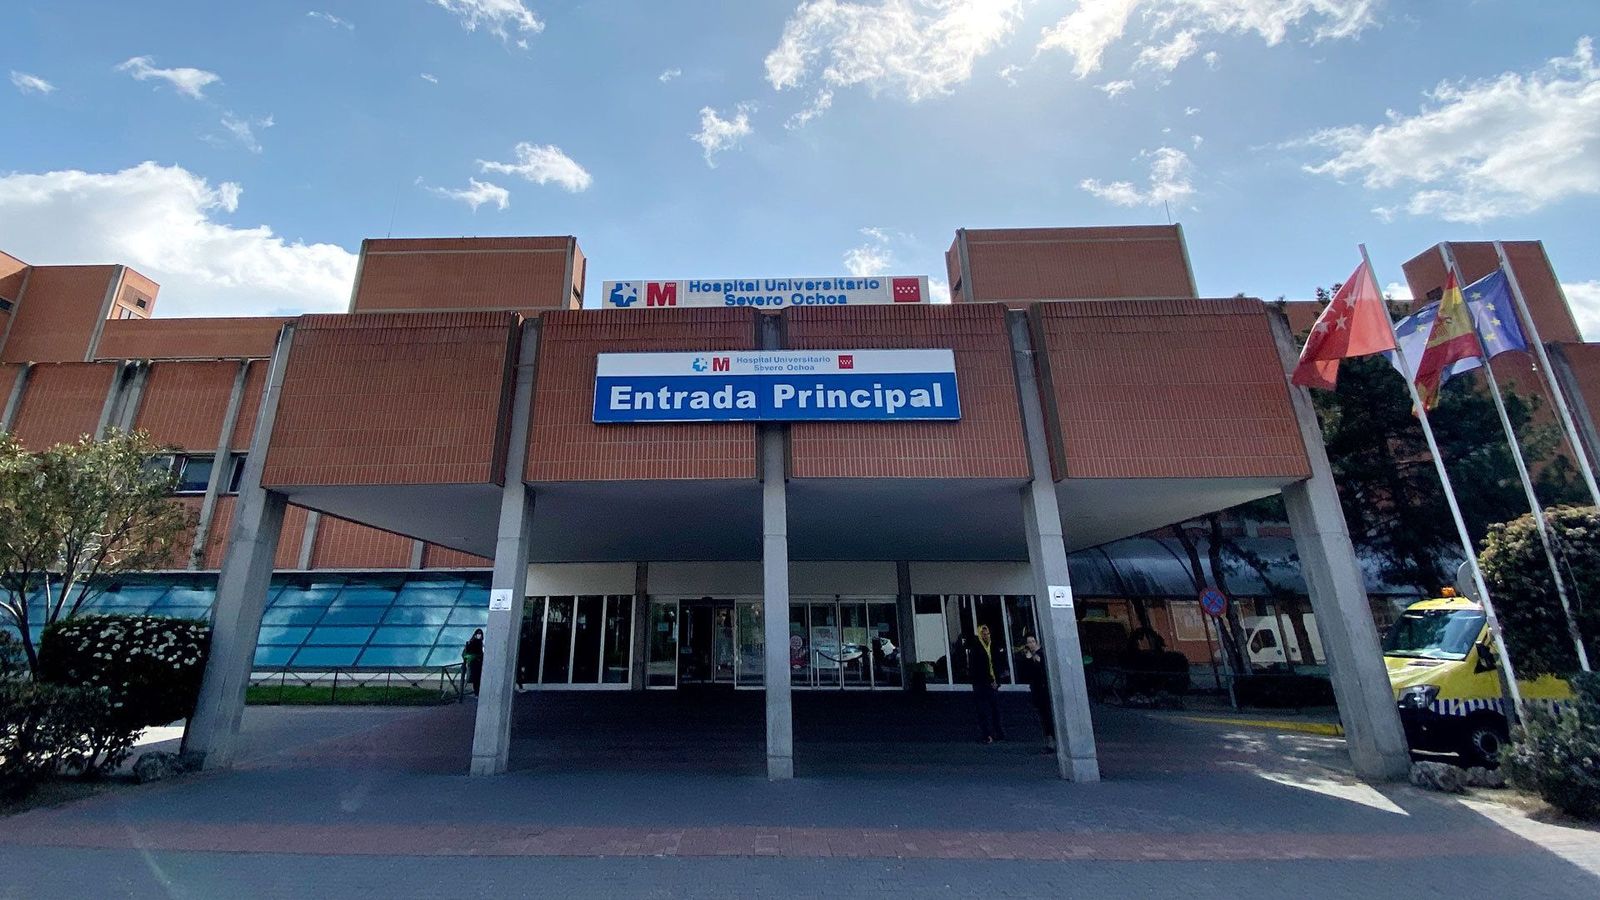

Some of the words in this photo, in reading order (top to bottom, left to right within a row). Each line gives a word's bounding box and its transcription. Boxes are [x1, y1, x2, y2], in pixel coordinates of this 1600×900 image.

[689, 279, 760, 294] Hospital
[766, 278, 880, 291] Universitario
[647, 282, 676, 307] M
[724, 293, 783, 306] Severo
[791, 292, 847, 305] Ochoa
[713, 357, 730, 371] M
[736, 355, 773, 365] Hospital
[773, 355, 831, 363] Universitario
[786, 363, 815, 371] Ochoa
[609, 385, 757, 410] Entrada
[773, 383, 944, 414] Principal
